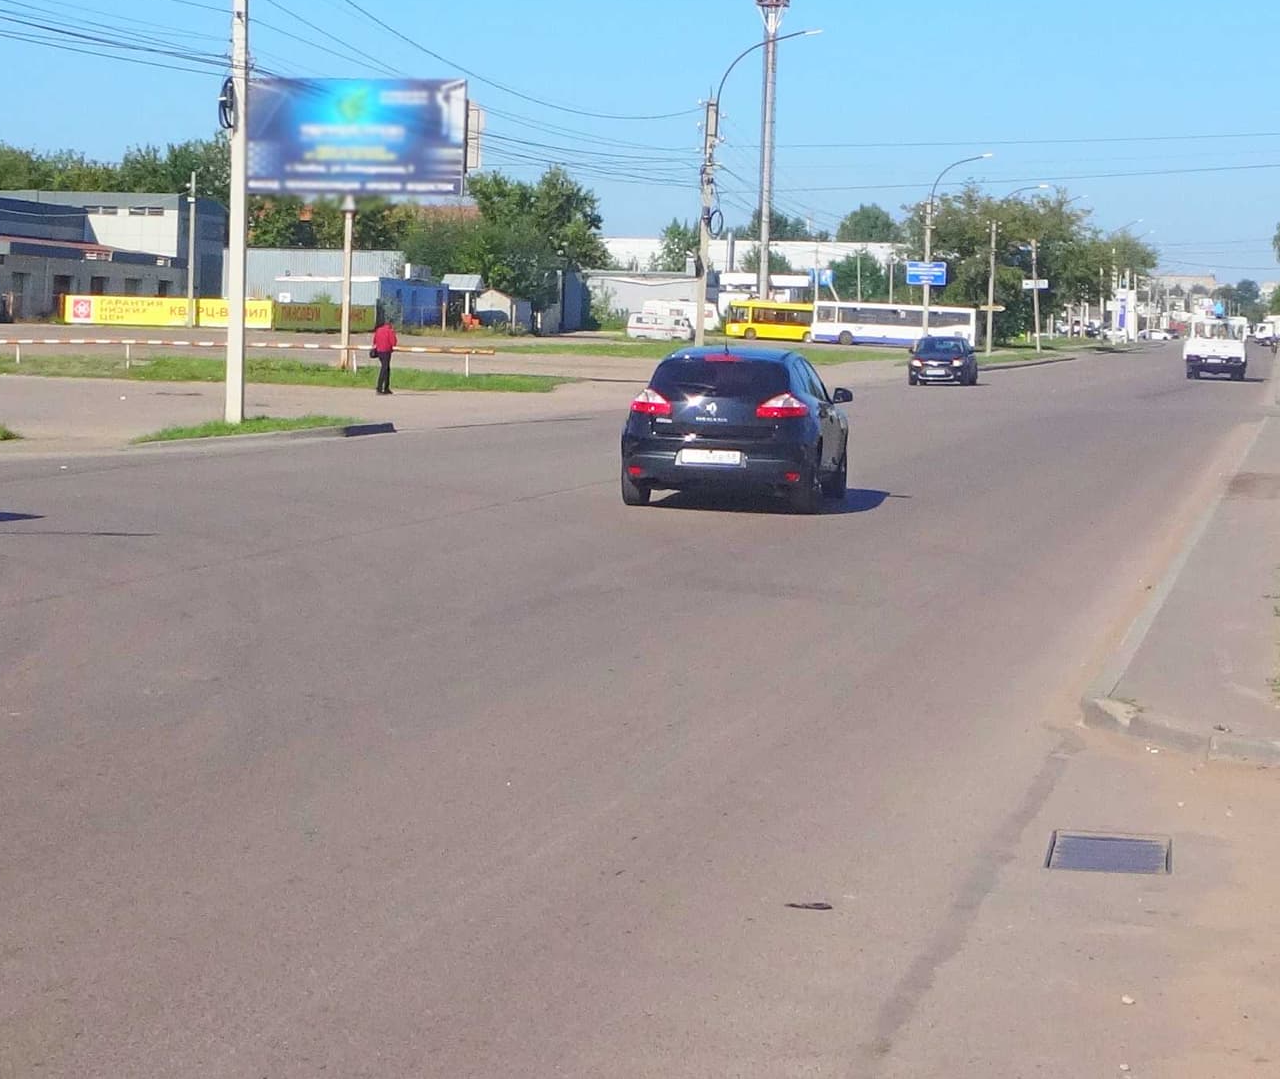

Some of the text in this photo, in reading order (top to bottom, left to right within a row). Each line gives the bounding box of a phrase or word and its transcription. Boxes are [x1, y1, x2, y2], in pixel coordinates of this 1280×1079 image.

[99, 298, 164, 307] ГАРАНТИЯ
[99, 306, 147, 314] НИЗКИХ
[99, 313, 125, 321] ЦЕН
